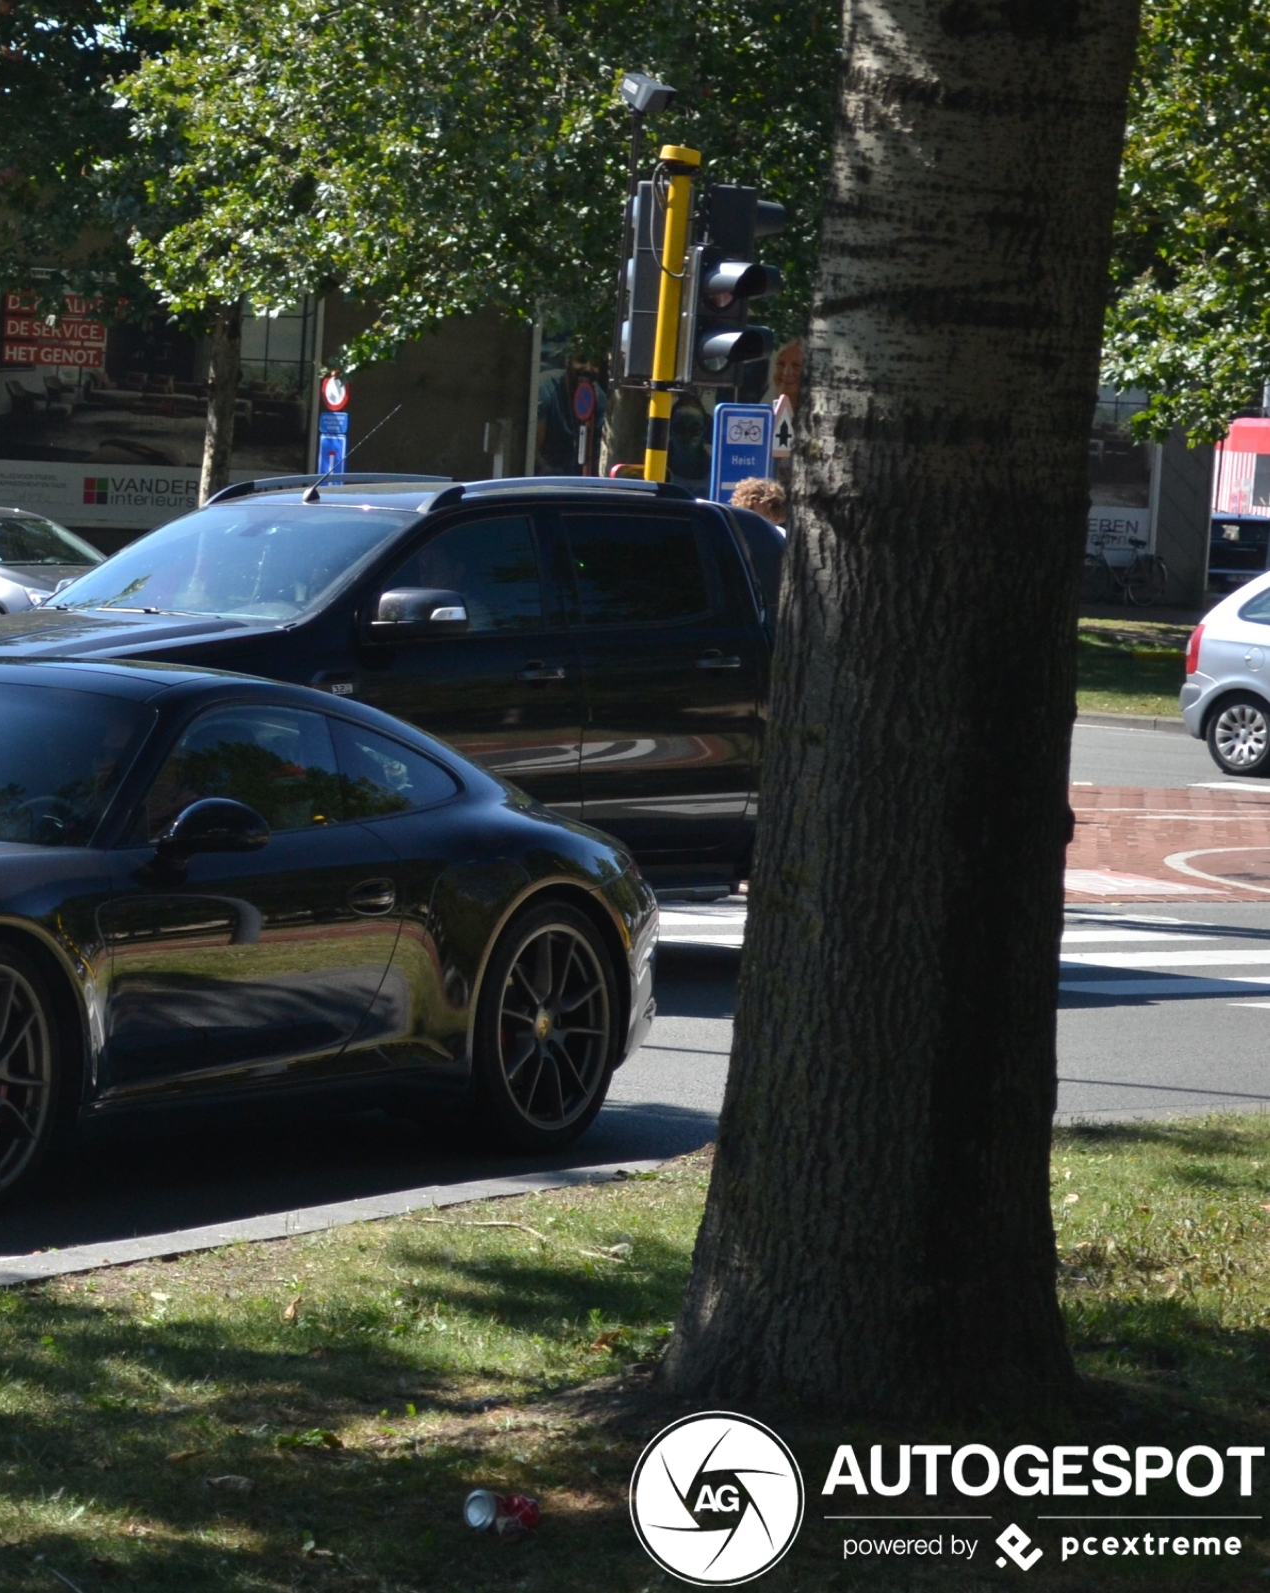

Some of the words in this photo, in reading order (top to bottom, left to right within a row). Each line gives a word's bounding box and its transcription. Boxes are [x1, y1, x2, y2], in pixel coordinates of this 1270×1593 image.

[6, 320, 29, 336] DE
[32, 321, 102, 340] SERVICE.
[4, 345, 38, 362] HET
[40, 347, 99, 365] GENOT.
[731, 455, 755, 466] Heist
[111, 477, 199, 495] VANDER
[110, 491, 196, 507] interieurs
